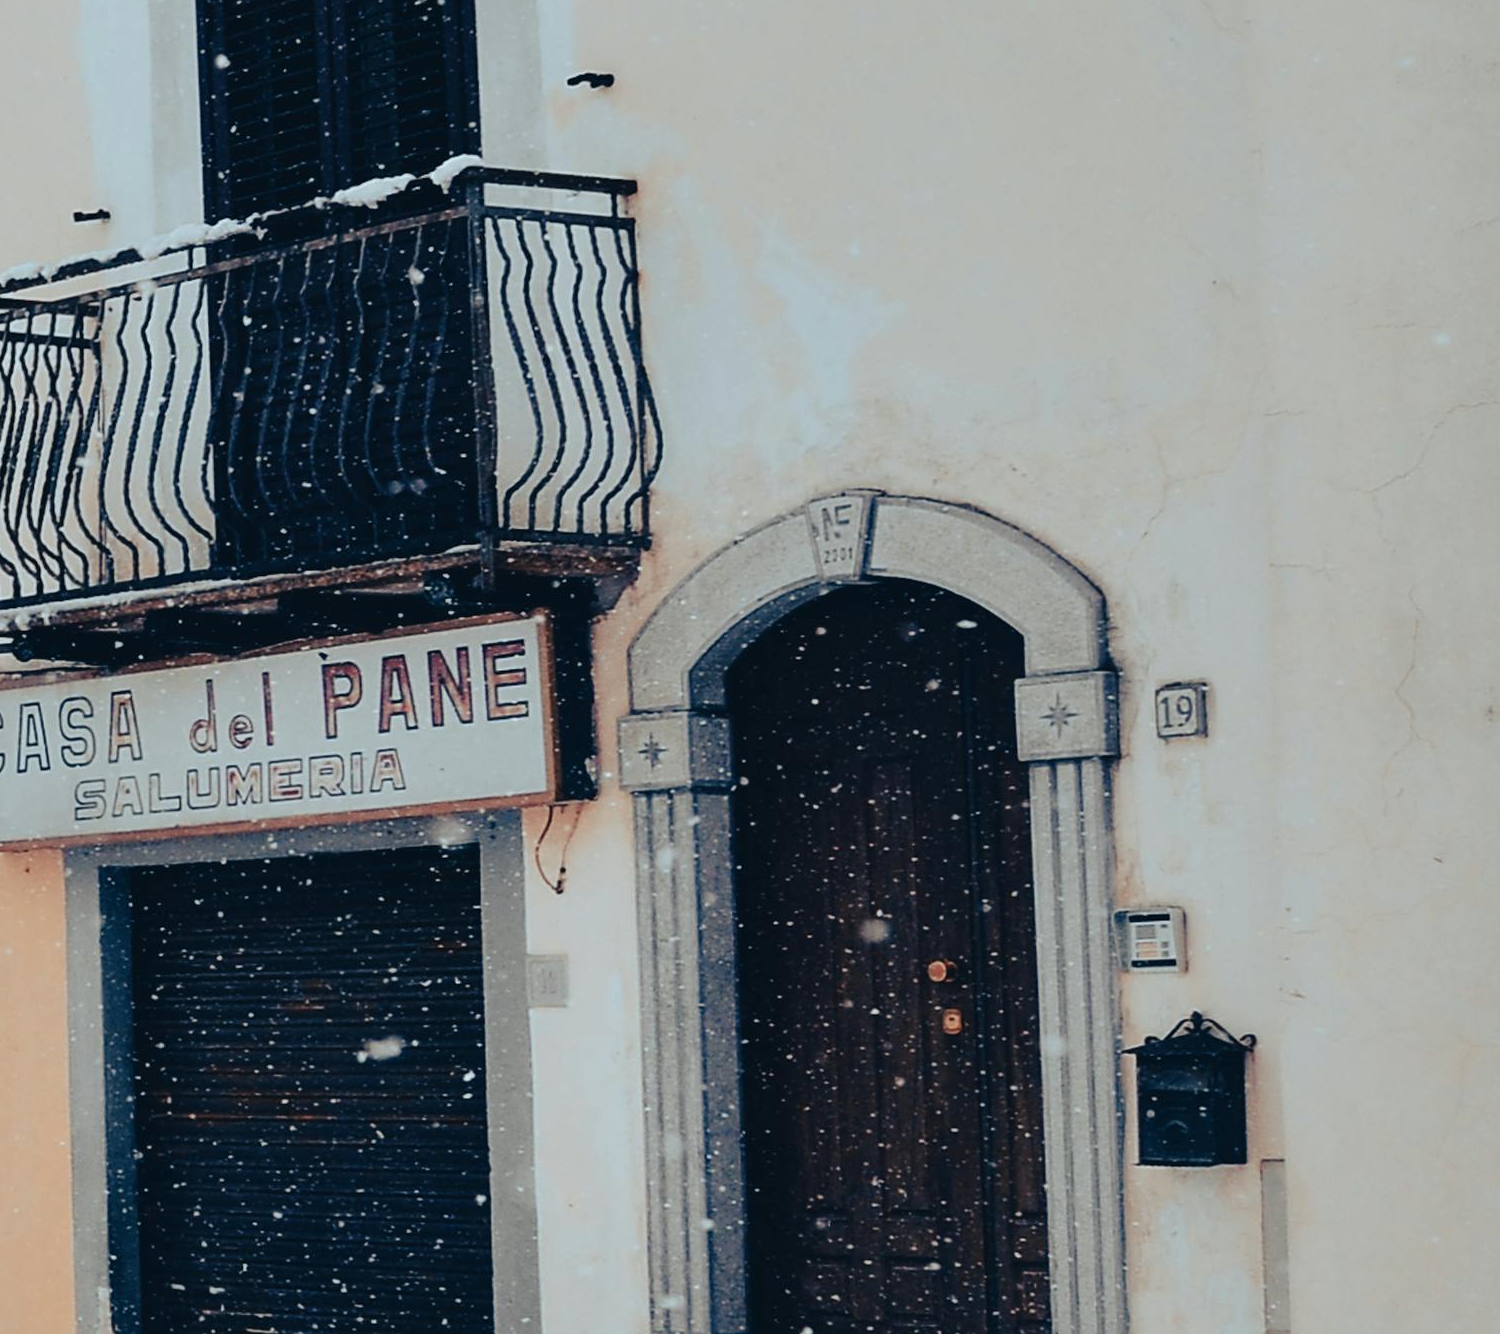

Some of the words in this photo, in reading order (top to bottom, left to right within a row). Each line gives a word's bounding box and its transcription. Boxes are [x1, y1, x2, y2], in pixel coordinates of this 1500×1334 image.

[189, 671, 275, 754] del
[320, 638, 530, 740] PANE
[1160, 695, 1193, 729] 19
[74, 747, 407, 821] SALUMERIA
